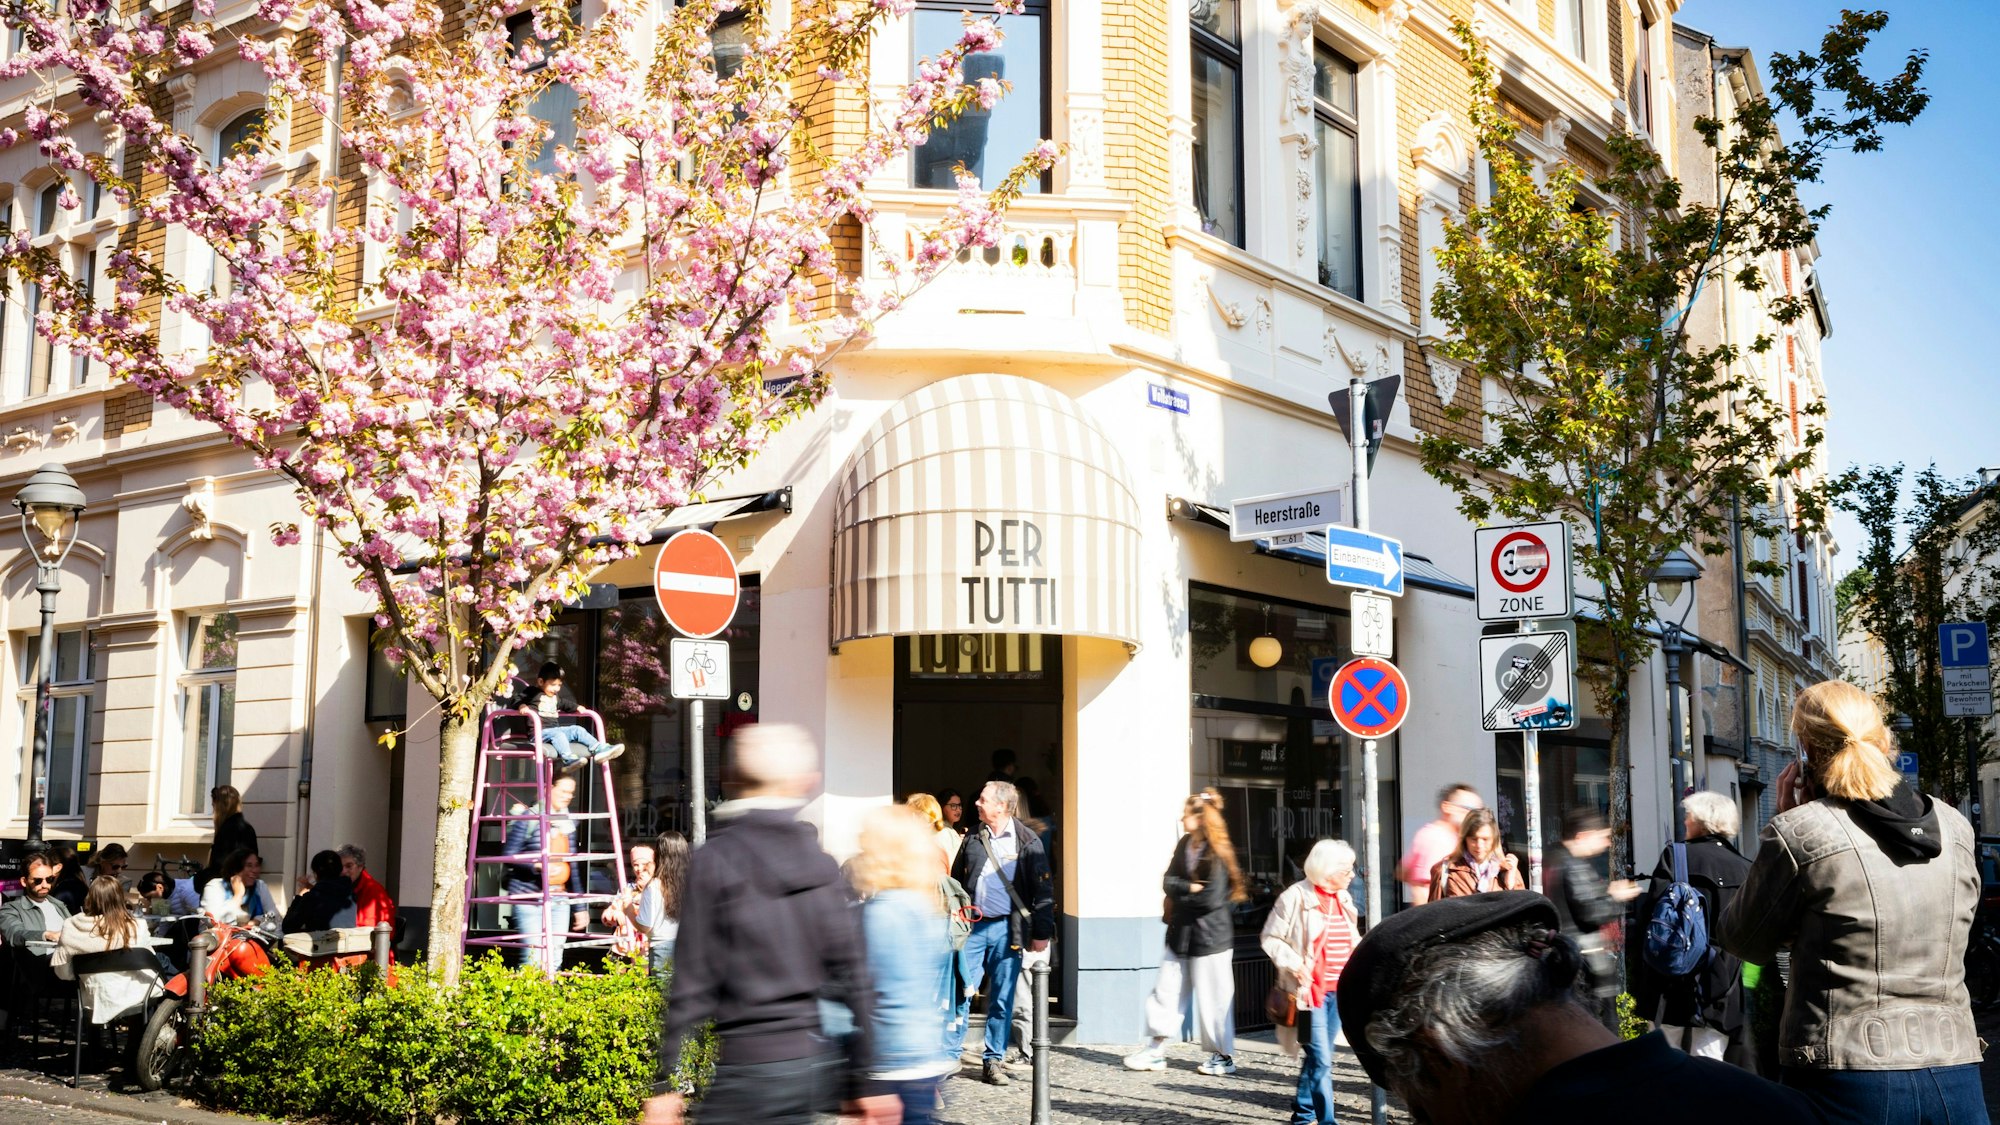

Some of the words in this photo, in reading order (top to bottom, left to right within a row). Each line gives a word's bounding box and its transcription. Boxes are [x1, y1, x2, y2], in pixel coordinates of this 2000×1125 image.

[1255, 501, 1320, 526] Heerstraße
[975, 520, 1042, 566] PER
[1288, 535, 1297, 543] 61
[1333, 548, 1386, 570] Einbahnstraße
[962, 577, 1057, 625] TUTTI
[1500, 596, 1544, 613] ZONE
[1951, 629, 1976, 661] P
[1949, 695, 1986, 703] Bewohner
[1901, 756, 1912, 770] P
[625, 803, 658, 837] PER
[1271, 807, 1296, 839] PER
